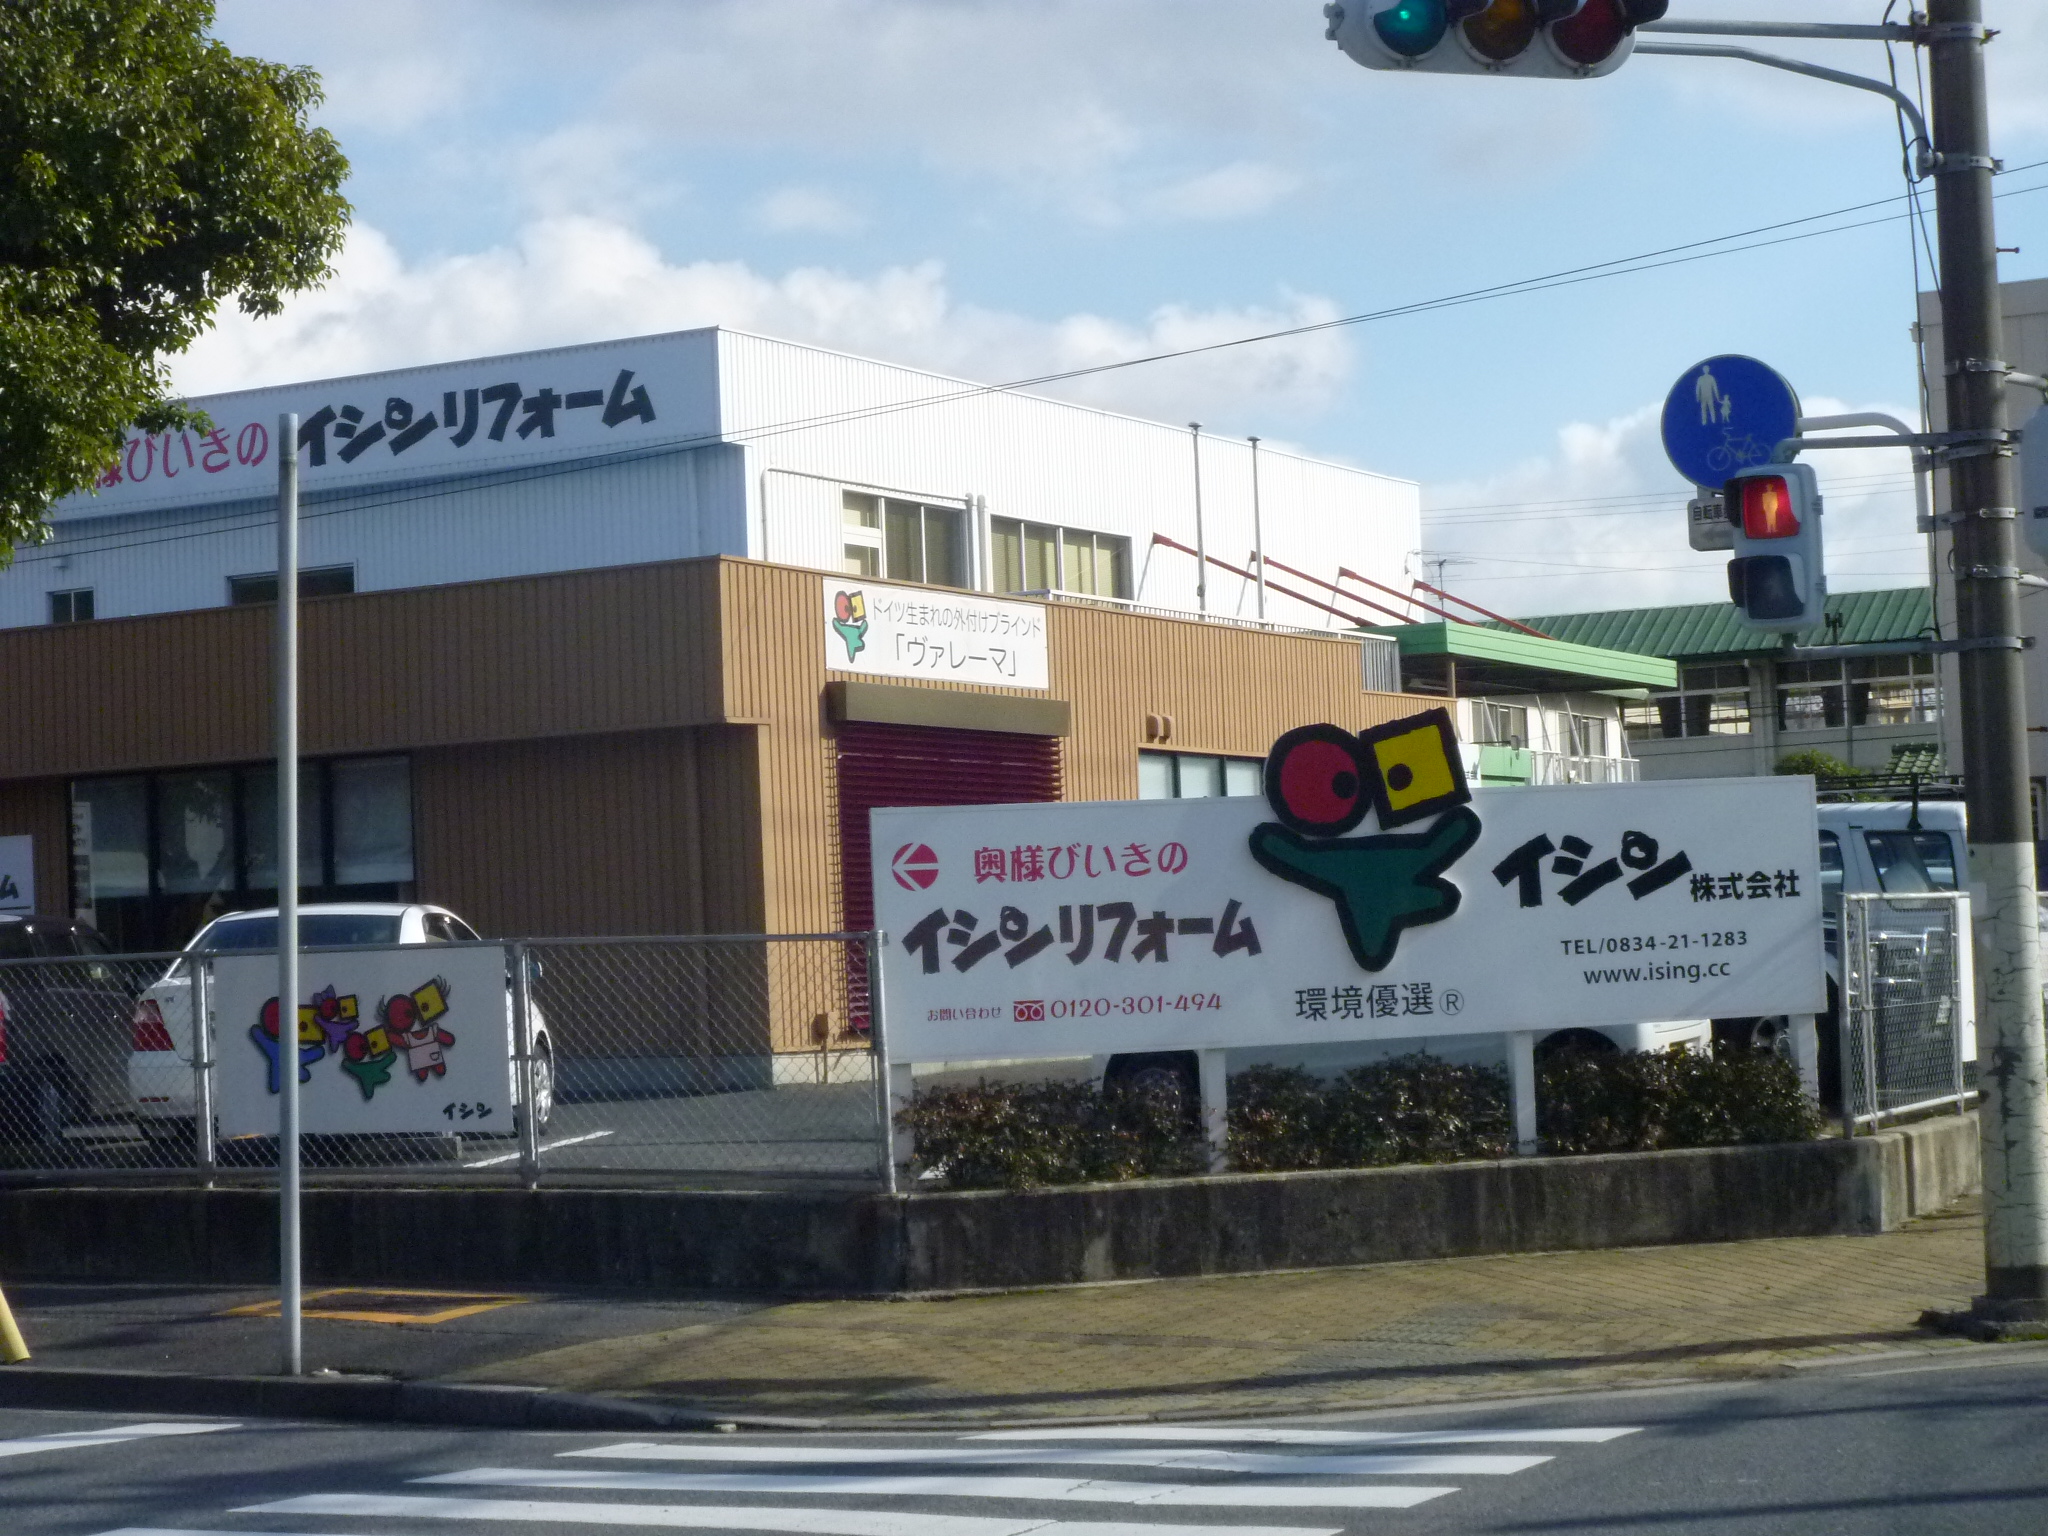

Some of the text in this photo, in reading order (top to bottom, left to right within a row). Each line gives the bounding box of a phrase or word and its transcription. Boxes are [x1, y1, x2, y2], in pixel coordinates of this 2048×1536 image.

[298, 368, 657, 468] イシンリフォーム
[873, 597, 1041, 639] ドイツ生まれの外付けブラインド
[974, 841, 1189, 885] 奥様びいきの
[1689, 868, 1802, 903] 株式会社
[901, 898, 1263, 976] イシンリフォーム
[1583, 959, 1732, 985] www.ising.cc
[926, 992, 1223, 1023] お問い合わせ 0120-301-494
